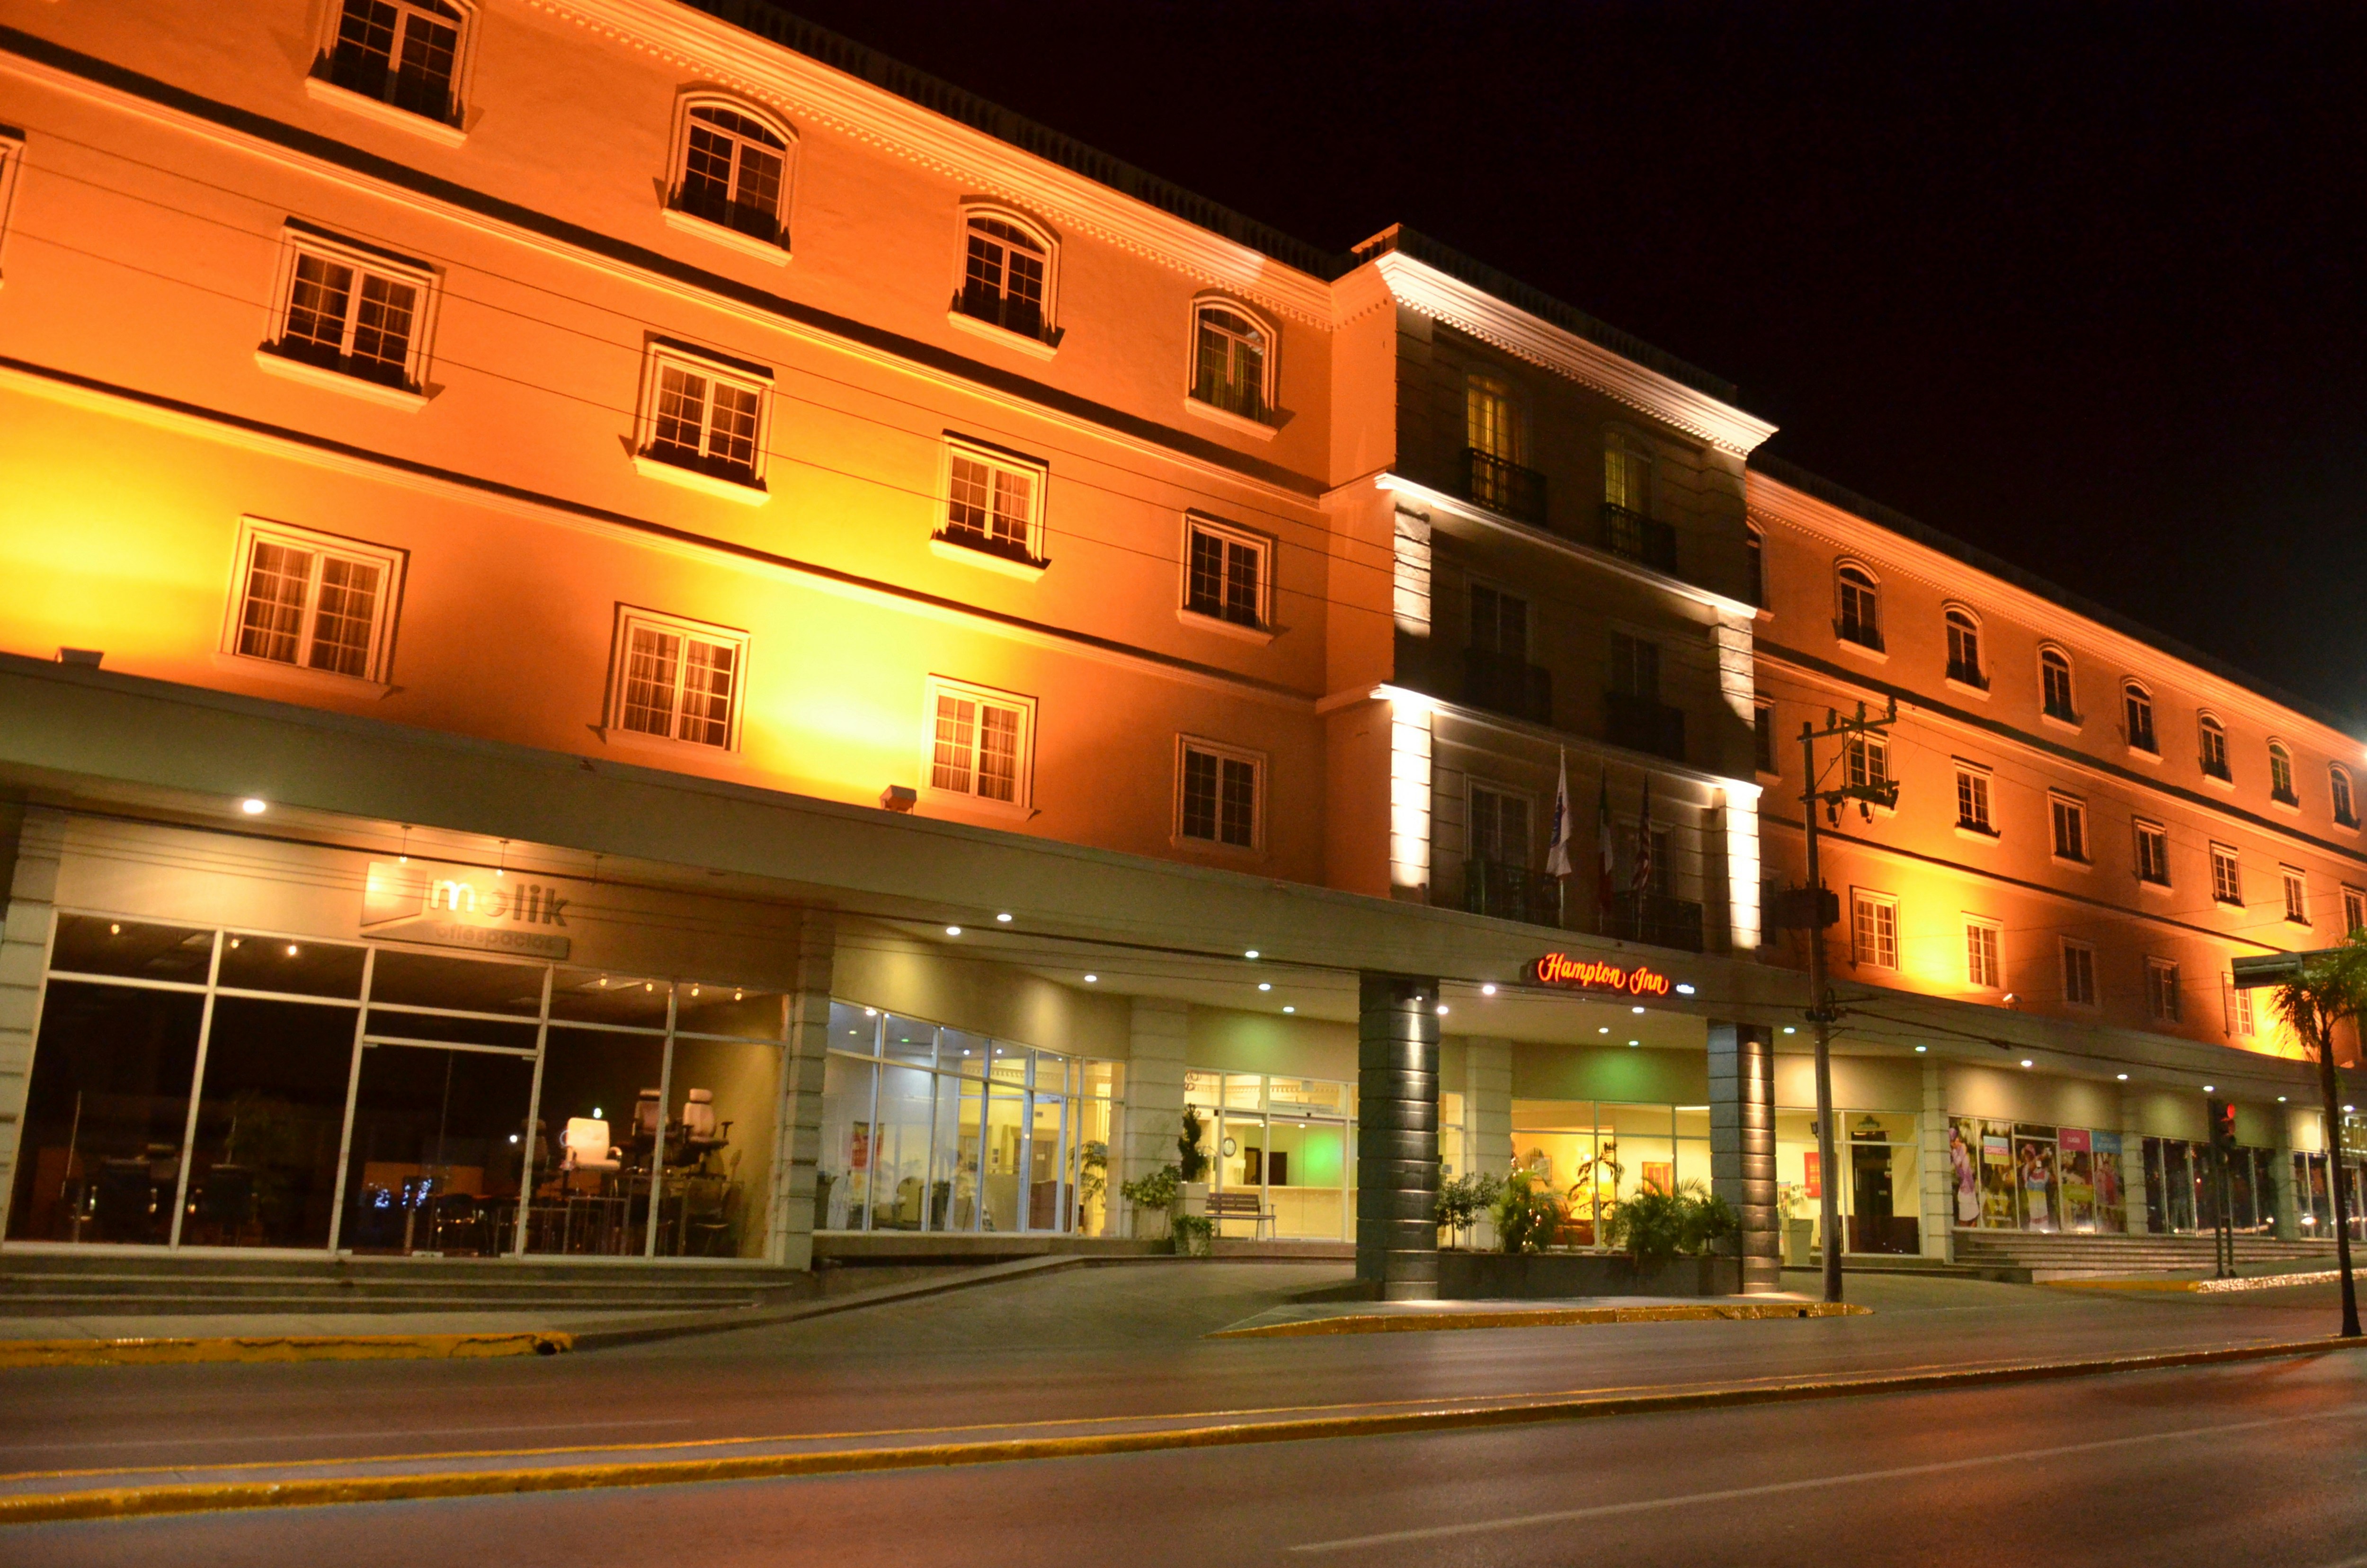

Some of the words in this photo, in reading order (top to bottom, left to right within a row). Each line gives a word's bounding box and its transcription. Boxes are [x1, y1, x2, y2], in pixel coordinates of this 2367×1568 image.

[430, 879, 570, 927] molik
[1538, 953, 1626, 988] Hampton
[1629, 967, 1669, 995] Inn
